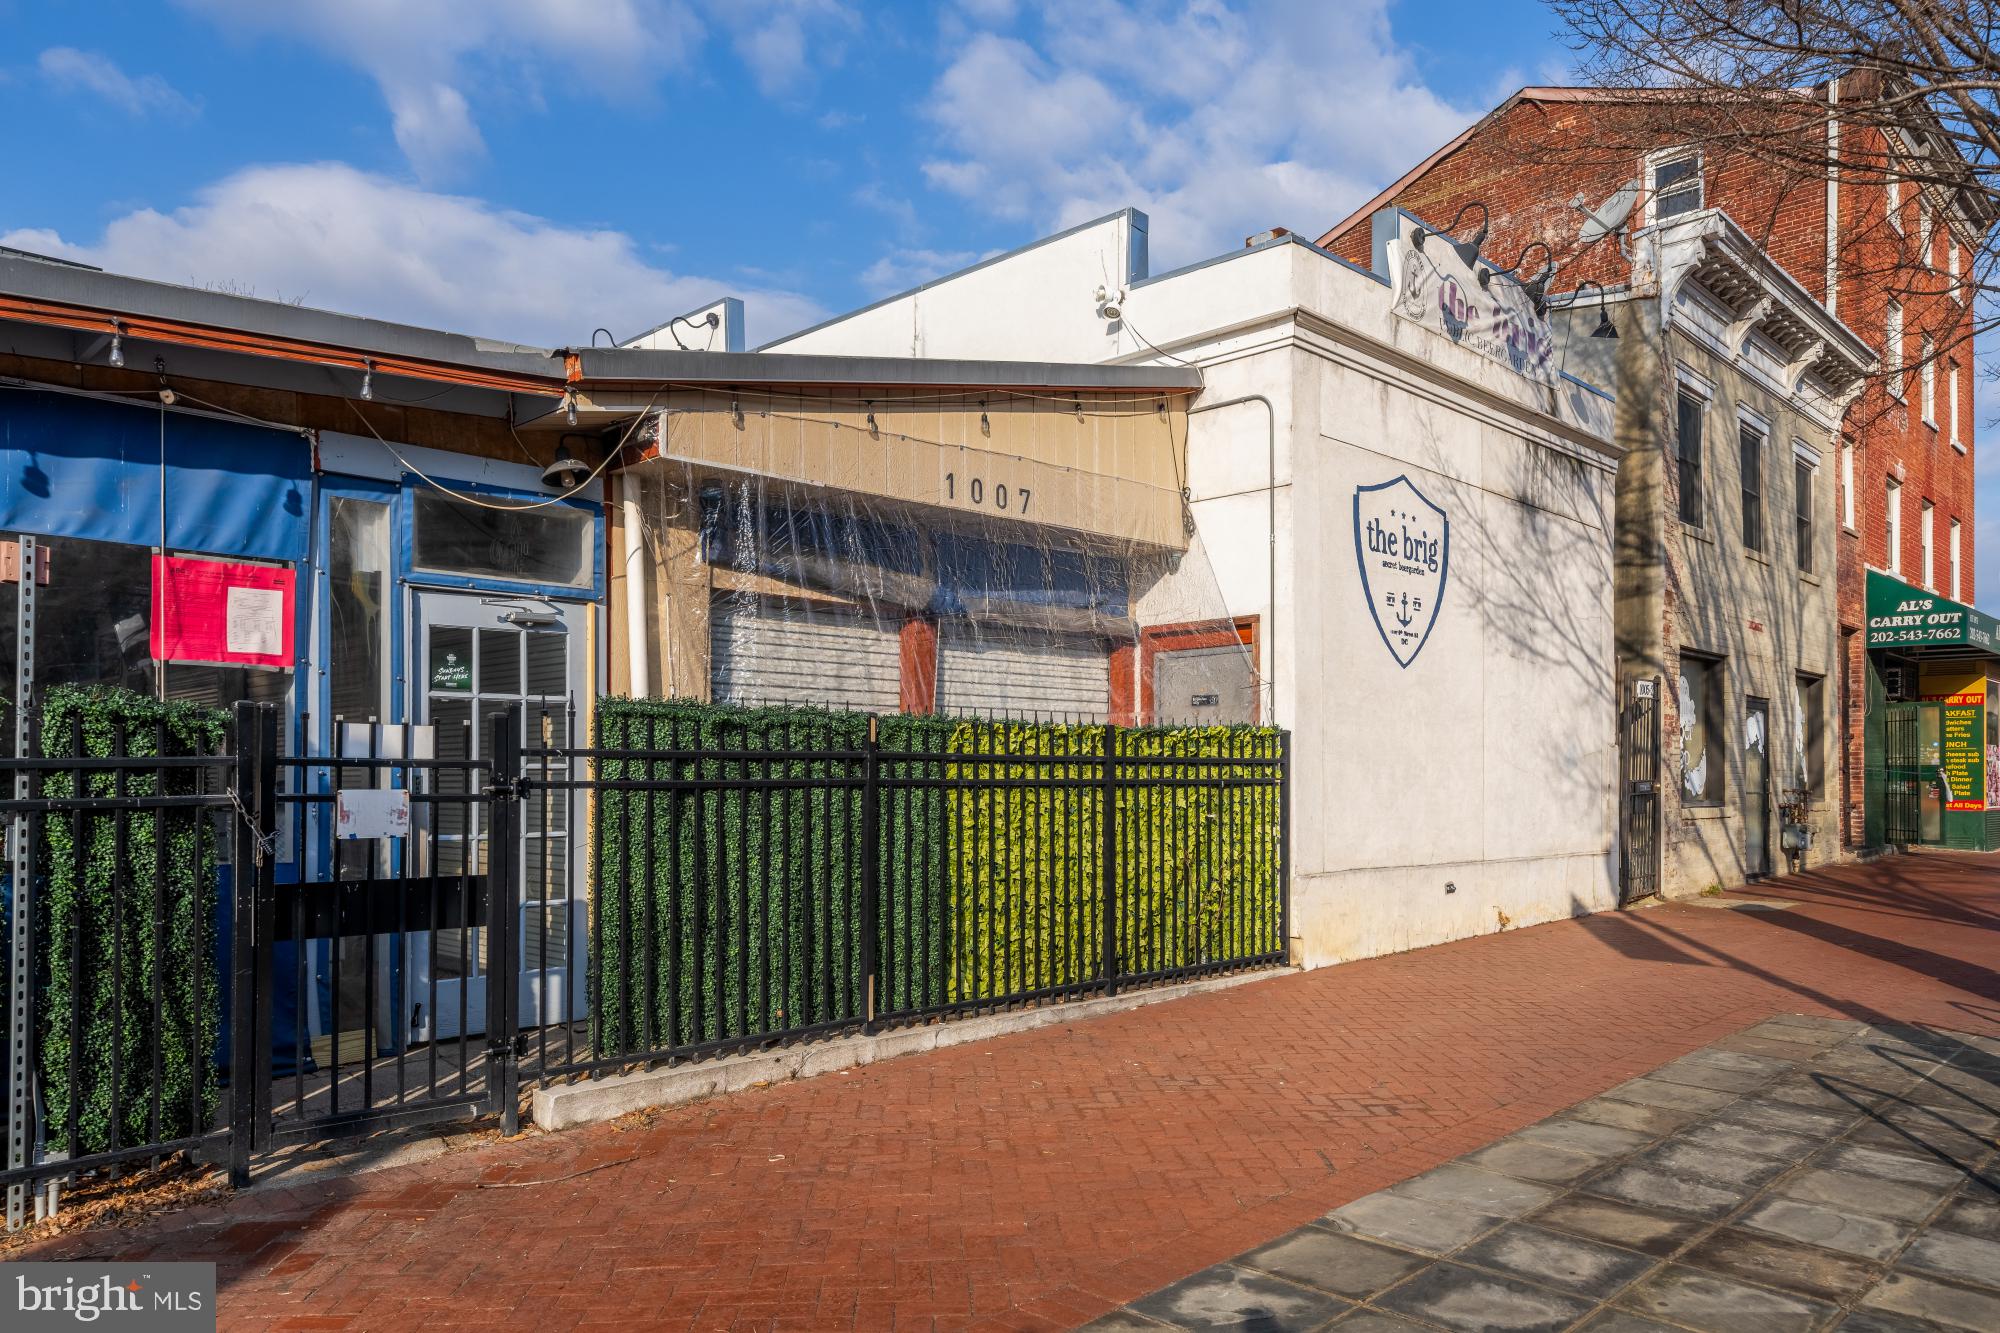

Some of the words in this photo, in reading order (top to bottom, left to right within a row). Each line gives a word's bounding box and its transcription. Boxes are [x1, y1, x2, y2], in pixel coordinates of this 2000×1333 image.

[946, 472, 1031, 514] 1007
[1366, 517, 1398, 557] the
[1402, 525, 1439, 574] brig
[1897, 599, 1933, 612] AL'S
[1870, 614, 1924, 628] CARRY
[1927, 612, 1962, 625] OUT
[1870, 627, 1961, 643] 202-543-7662
[1965, 695, 1983, 704] OUT
[1964, 802, 1983, 810] Days
